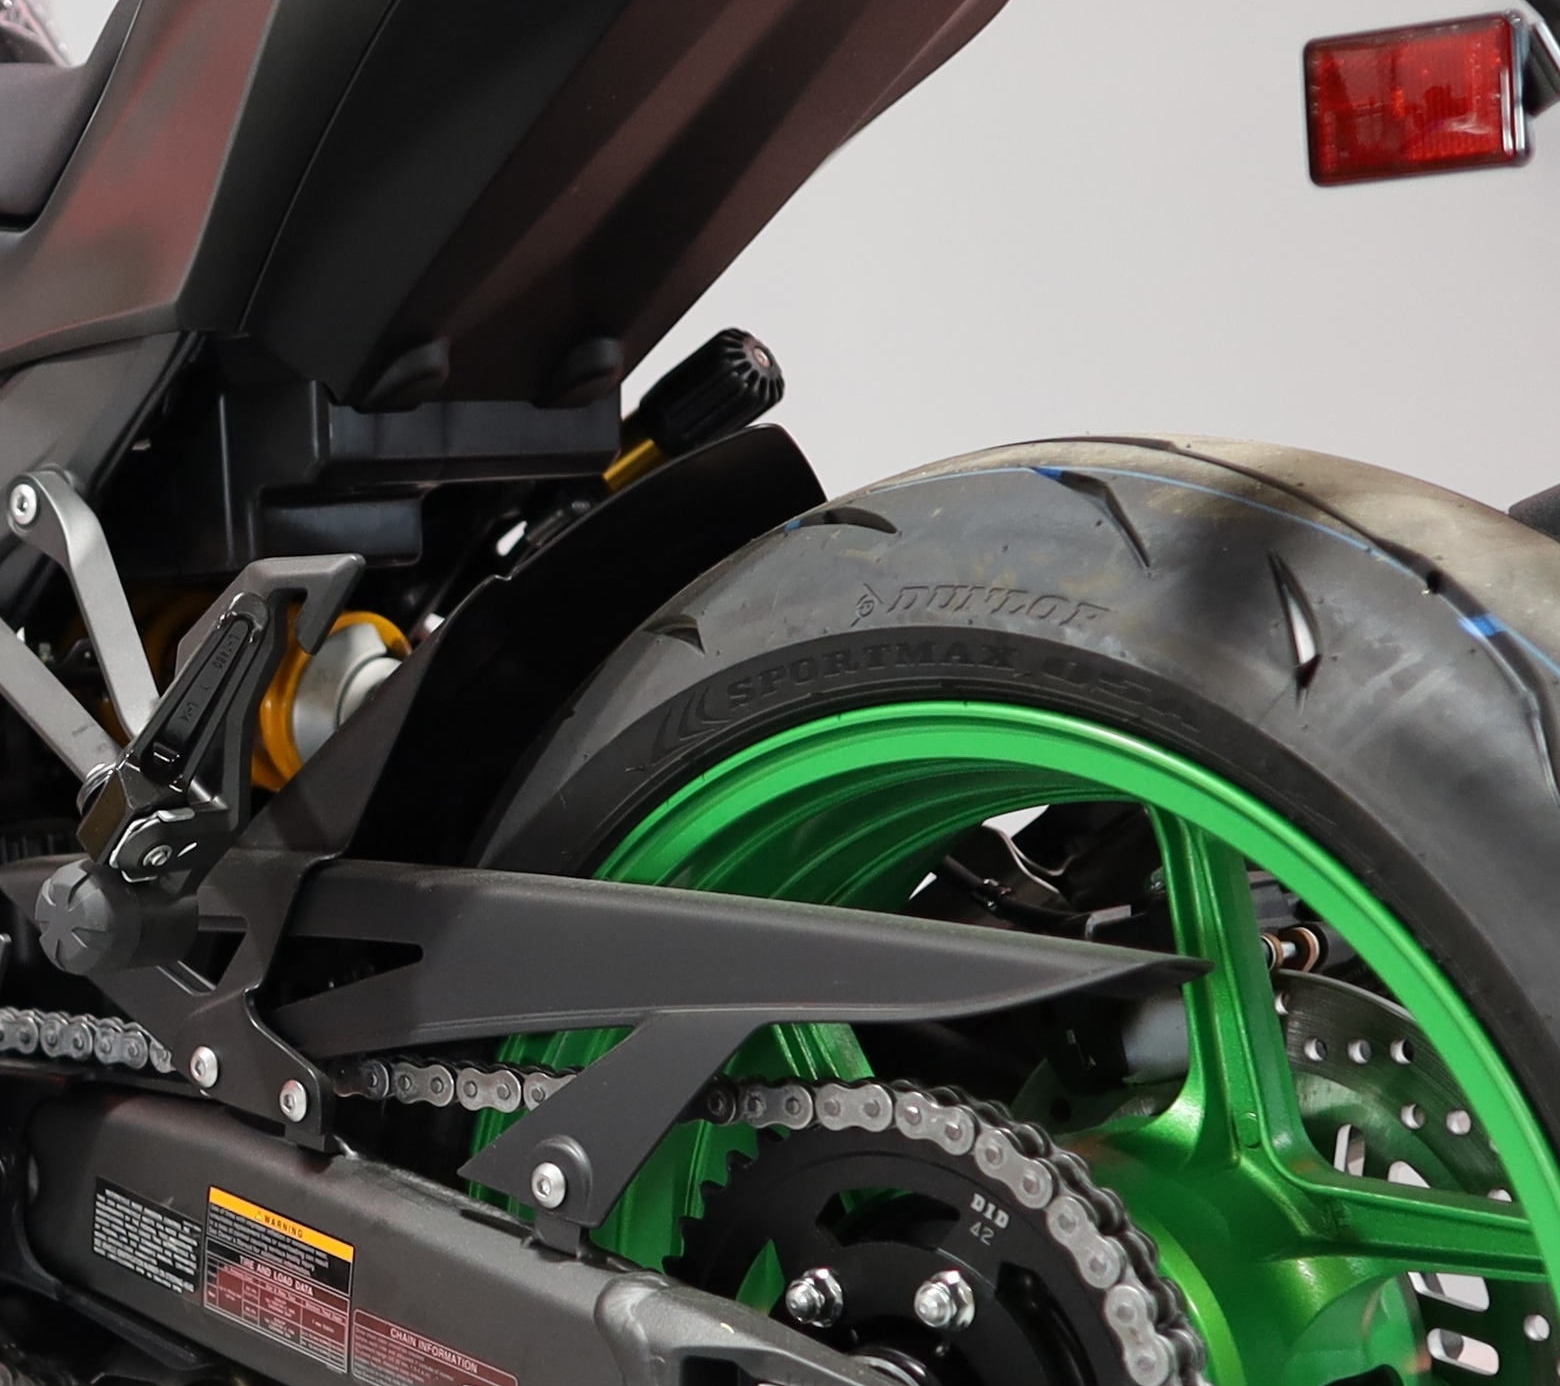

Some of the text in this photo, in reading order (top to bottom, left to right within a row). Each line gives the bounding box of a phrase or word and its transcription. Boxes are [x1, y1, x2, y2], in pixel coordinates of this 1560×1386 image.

[886, 583, 1112, 627] DUNLOP
[727, 642, 1016, 709] SPORTMAX
[264, 1215, 304, 1239] WARNING
[970, 1193, 1009, 1228] DID
[970, 1222, 994, 1246] 42
[239, 1255, 314, 1297] TIRE AND LOAD DATA
[389, 1327, 479, 1374] CHAIN INFORMATION
